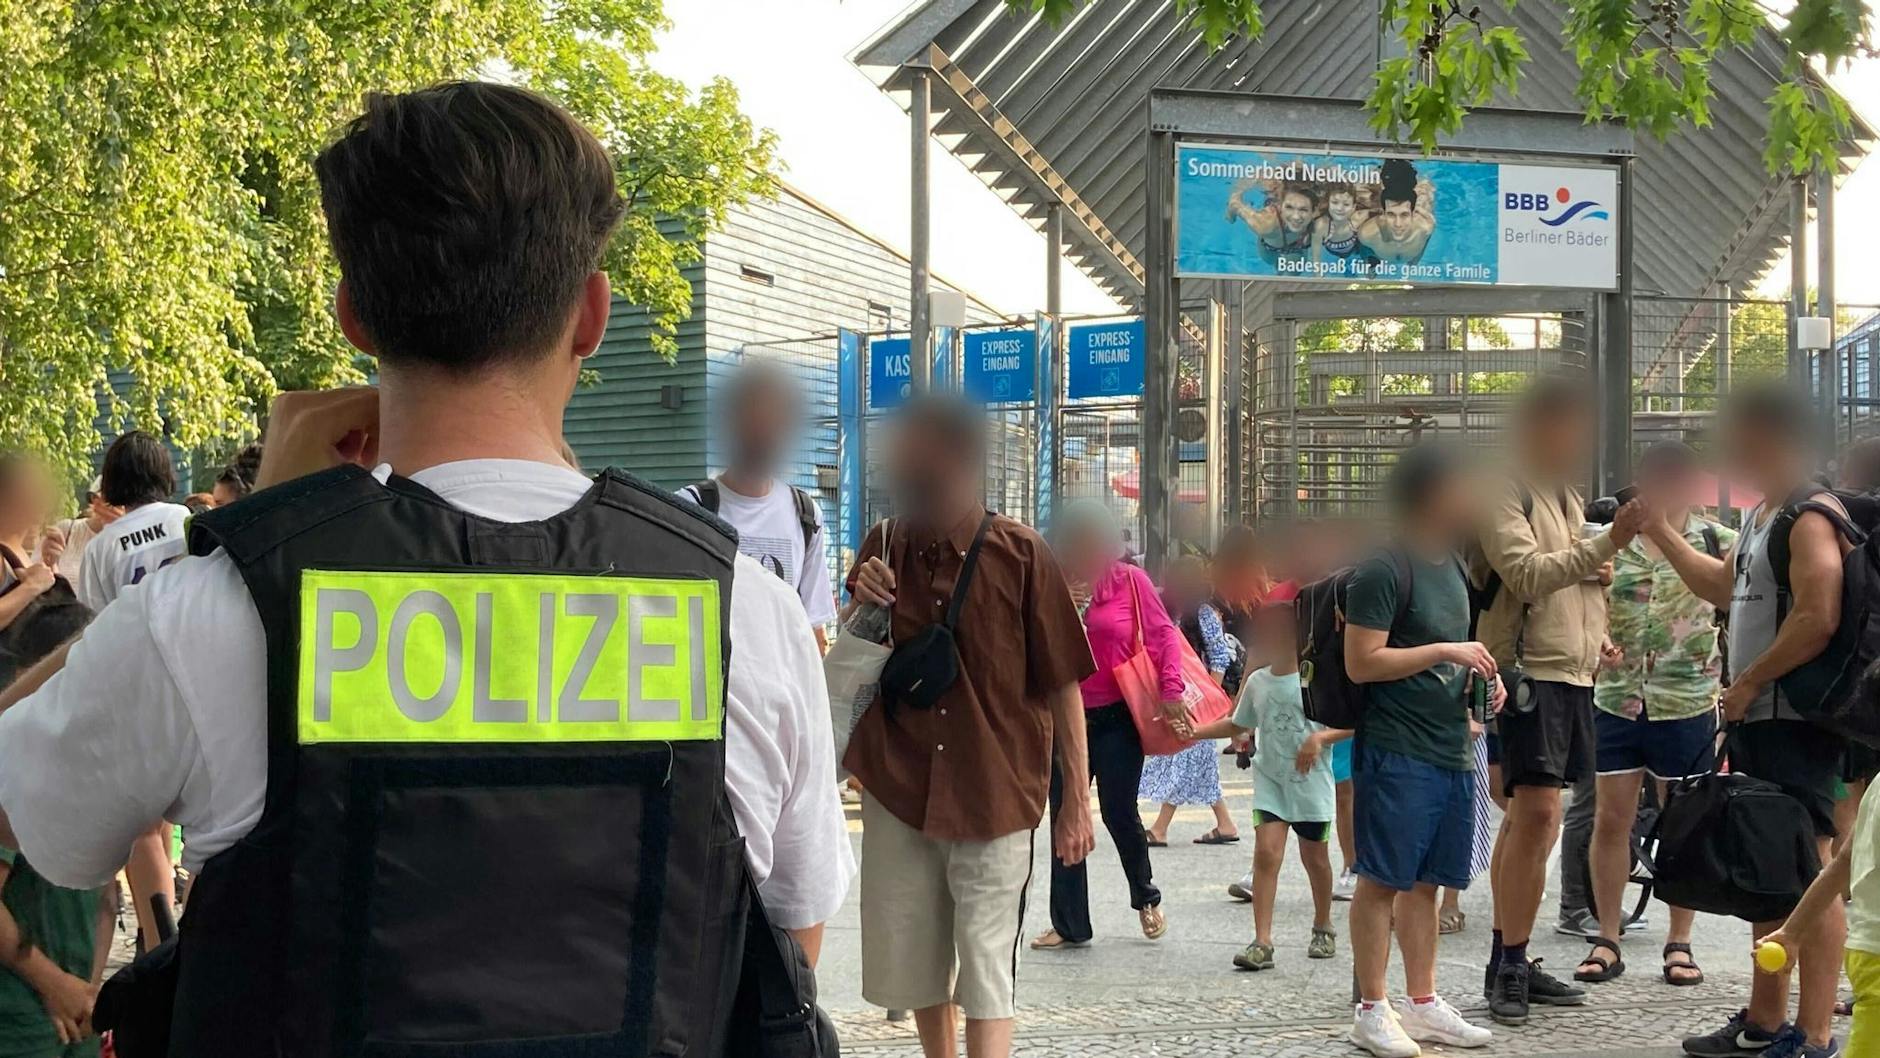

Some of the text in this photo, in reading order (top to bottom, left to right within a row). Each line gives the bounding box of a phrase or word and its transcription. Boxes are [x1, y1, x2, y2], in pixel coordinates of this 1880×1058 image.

[1187, 157, 1381, 184] Sommerbad Neukölln
[1504, 192, 1550, 211] BBB
[1504, 227, 1609, 246] Berliner Bäder
[1277, 256, 1344, 276] Badespaß
[1350, 259, 1372, 275] für
[1375, 260, 1396, 275] die
[1400, 264, 1442, 280] ganze
[981, 339, 1025, 356] EXPRESS-
[1088, 331, 1134, 348] EXPRESS-
[885, 353, 911, 377] KAS
[982, 356, 1020, 372] EINGANG
[1089, 348, 1130, 365] EINGANG
[119, 522, 167, 551] PUNK
[313, 587, 708, 723] POLIZEI
